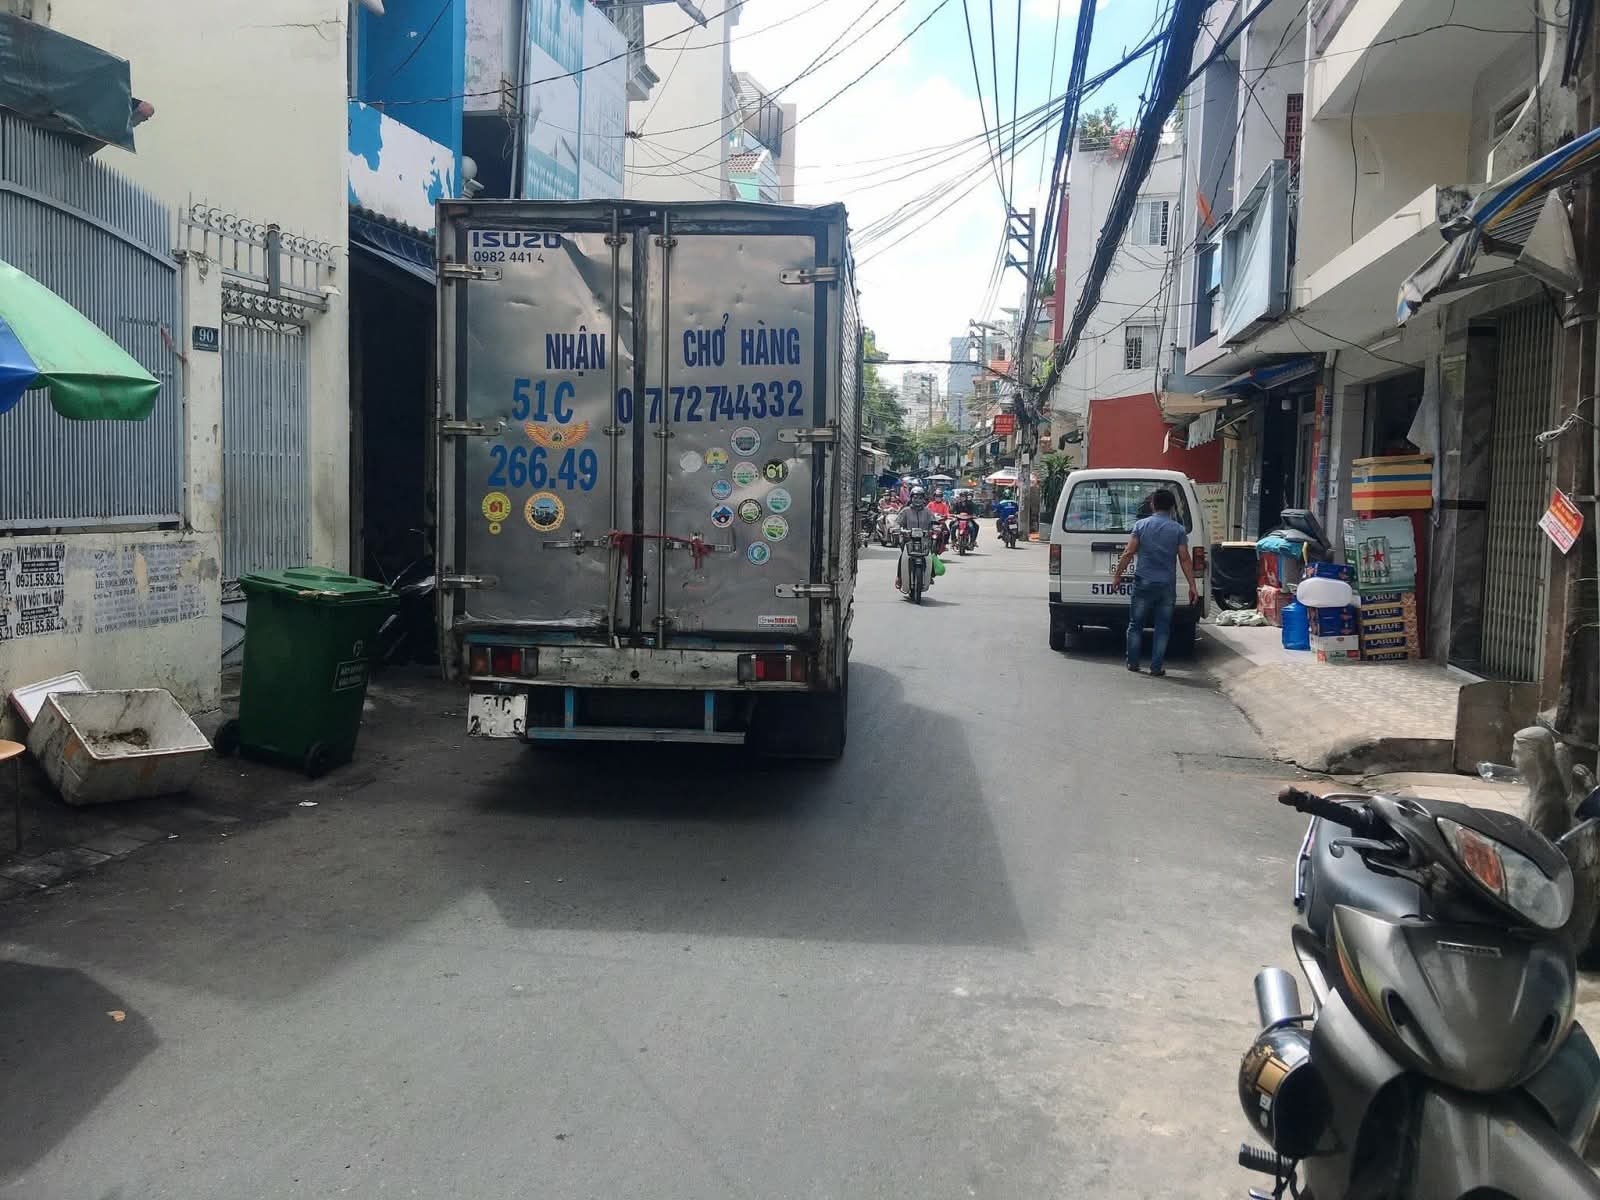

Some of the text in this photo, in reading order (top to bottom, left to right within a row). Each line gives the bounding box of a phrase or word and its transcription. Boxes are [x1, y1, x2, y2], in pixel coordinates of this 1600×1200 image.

[473, 232, 562, 248] ISUZU
[474, 251, 505, 262] 0982
[199, 328, 214, 343] 90
[545, 313, 800, 376] NHẬN CHỞ HÀNG
[512, 377, 575, 424] 51C
[488, 445, 598, 491] 266.49
[1367, 608, 1399, 616] LARUE
[1369, 623, 1401, 631] LARUE
